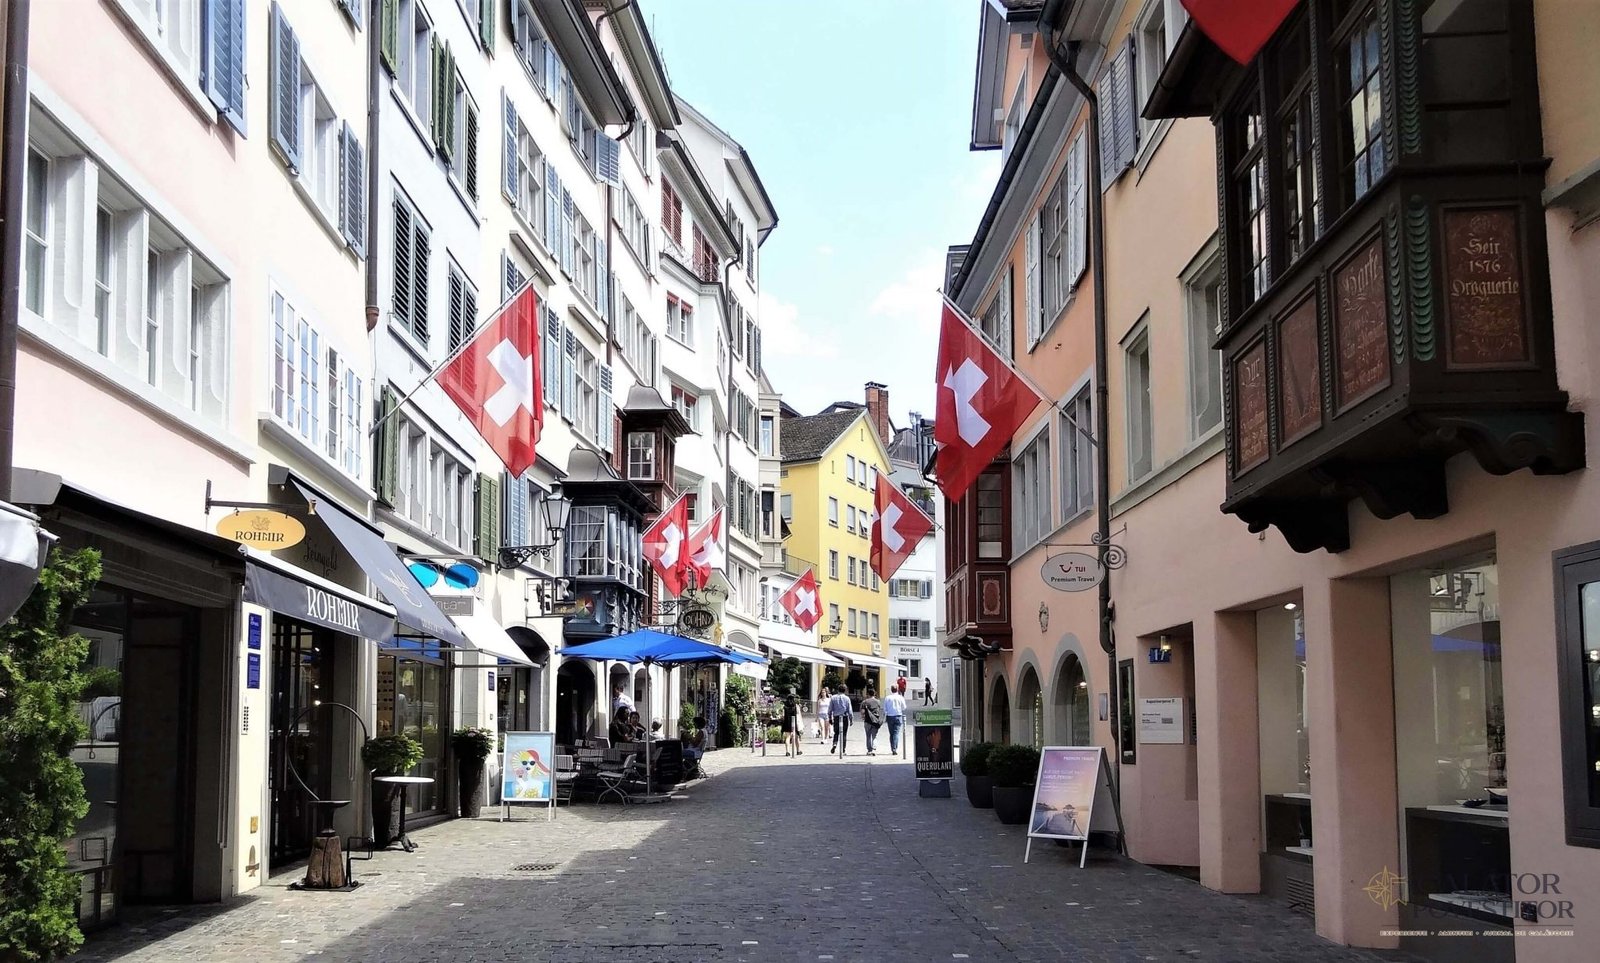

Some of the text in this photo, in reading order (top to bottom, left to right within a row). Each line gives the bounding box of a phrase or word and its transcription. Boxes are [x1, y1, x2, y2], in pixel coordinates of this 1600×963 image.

[1469, 260, 1501, 273] 1876
[1451, 277, 1519, 297] Droguerie
[235, 531, 285, 542] ROHMIR
[306, 585, 361, 632] ROHMIR
[917, 761, 952, 772] QUERULANT
